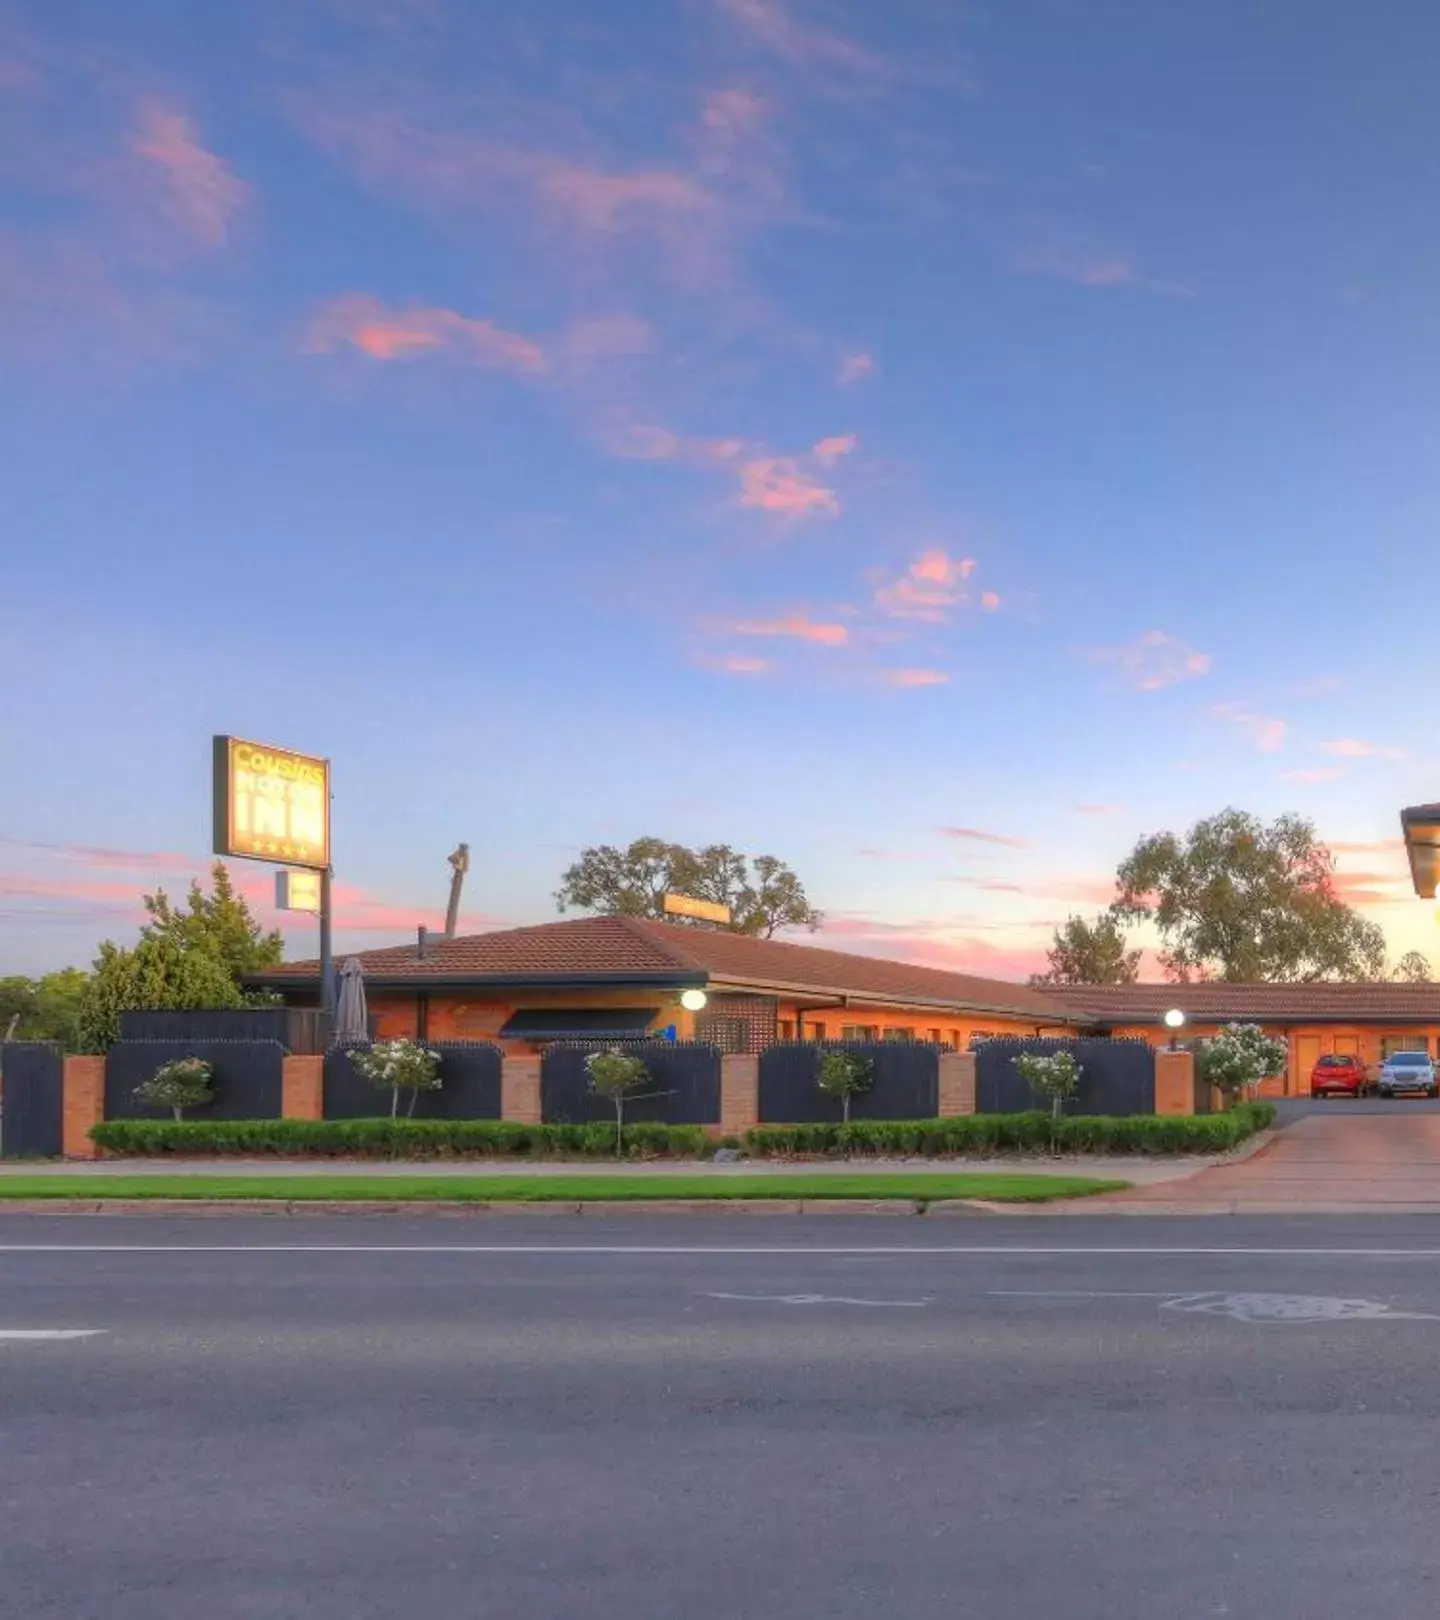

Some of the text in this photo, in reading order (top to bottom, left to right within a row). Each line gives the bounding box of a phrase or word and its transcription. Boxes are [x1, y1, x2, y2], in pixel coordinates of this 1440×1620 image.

[235, 743, 324, 783] Cousins
[236, 769, 322, 805] MOTO
[236, 791, 322, 845] INN
